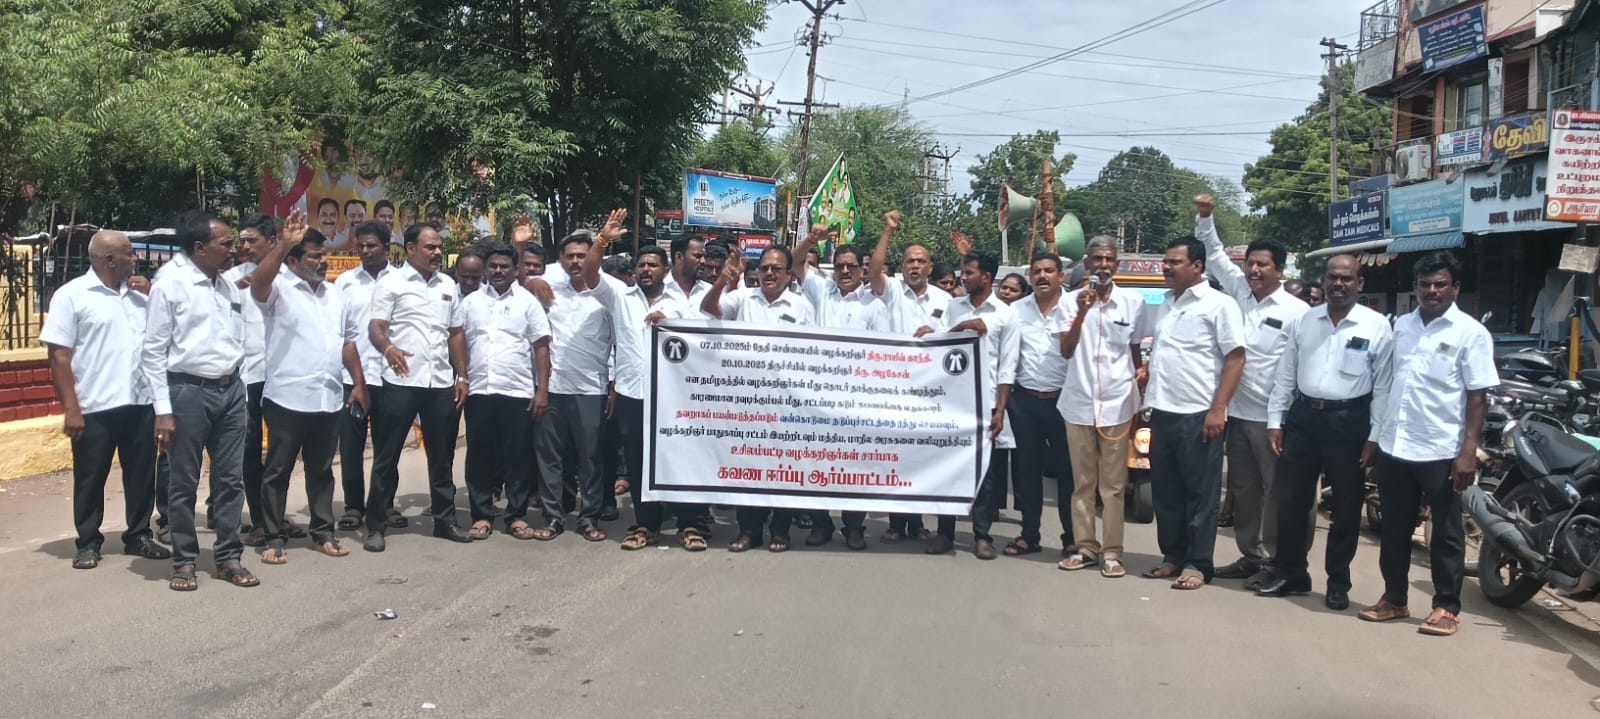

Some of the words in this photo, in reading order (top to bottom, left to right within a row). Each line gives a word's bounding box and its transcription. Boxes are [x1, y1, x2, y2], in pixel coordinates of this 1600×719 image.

[1357, 222, 1380, 235] MEDICALS
[753, 342, 771, 353] தேதி
[721, 359, 766, 369] 20.10.2025
[685, 376, 699, 384] என
[700, 375, 745, 387] தமிழகத்தில்
[747, 378, 806, 390] வழக்கறிஞர்கள்
[807, 380, 822, 391] மீது
[690, 393, 733, 402] காரணமான
[676, 409, 712, 419] தவறாகப்
[659, 425, 705, 437] வழக்கறிஞர்
[706, 428, 744, 439] பாதுகாப்பு
[745, 429, 768, 439] சட்டம்
[848, 434, 872, 445] மாநில
[731, 443, 784, 459] உசிலம்பட்டி
[786, 446, 859, 462] வழக்கறிஞர்கள்
[861, 449, 899, 462] சார்பாக
[766, 463, 804, 487] ஈர்ப்பு
[807, 466, 912, 488] ஆர்ப்பாட்டம்...
